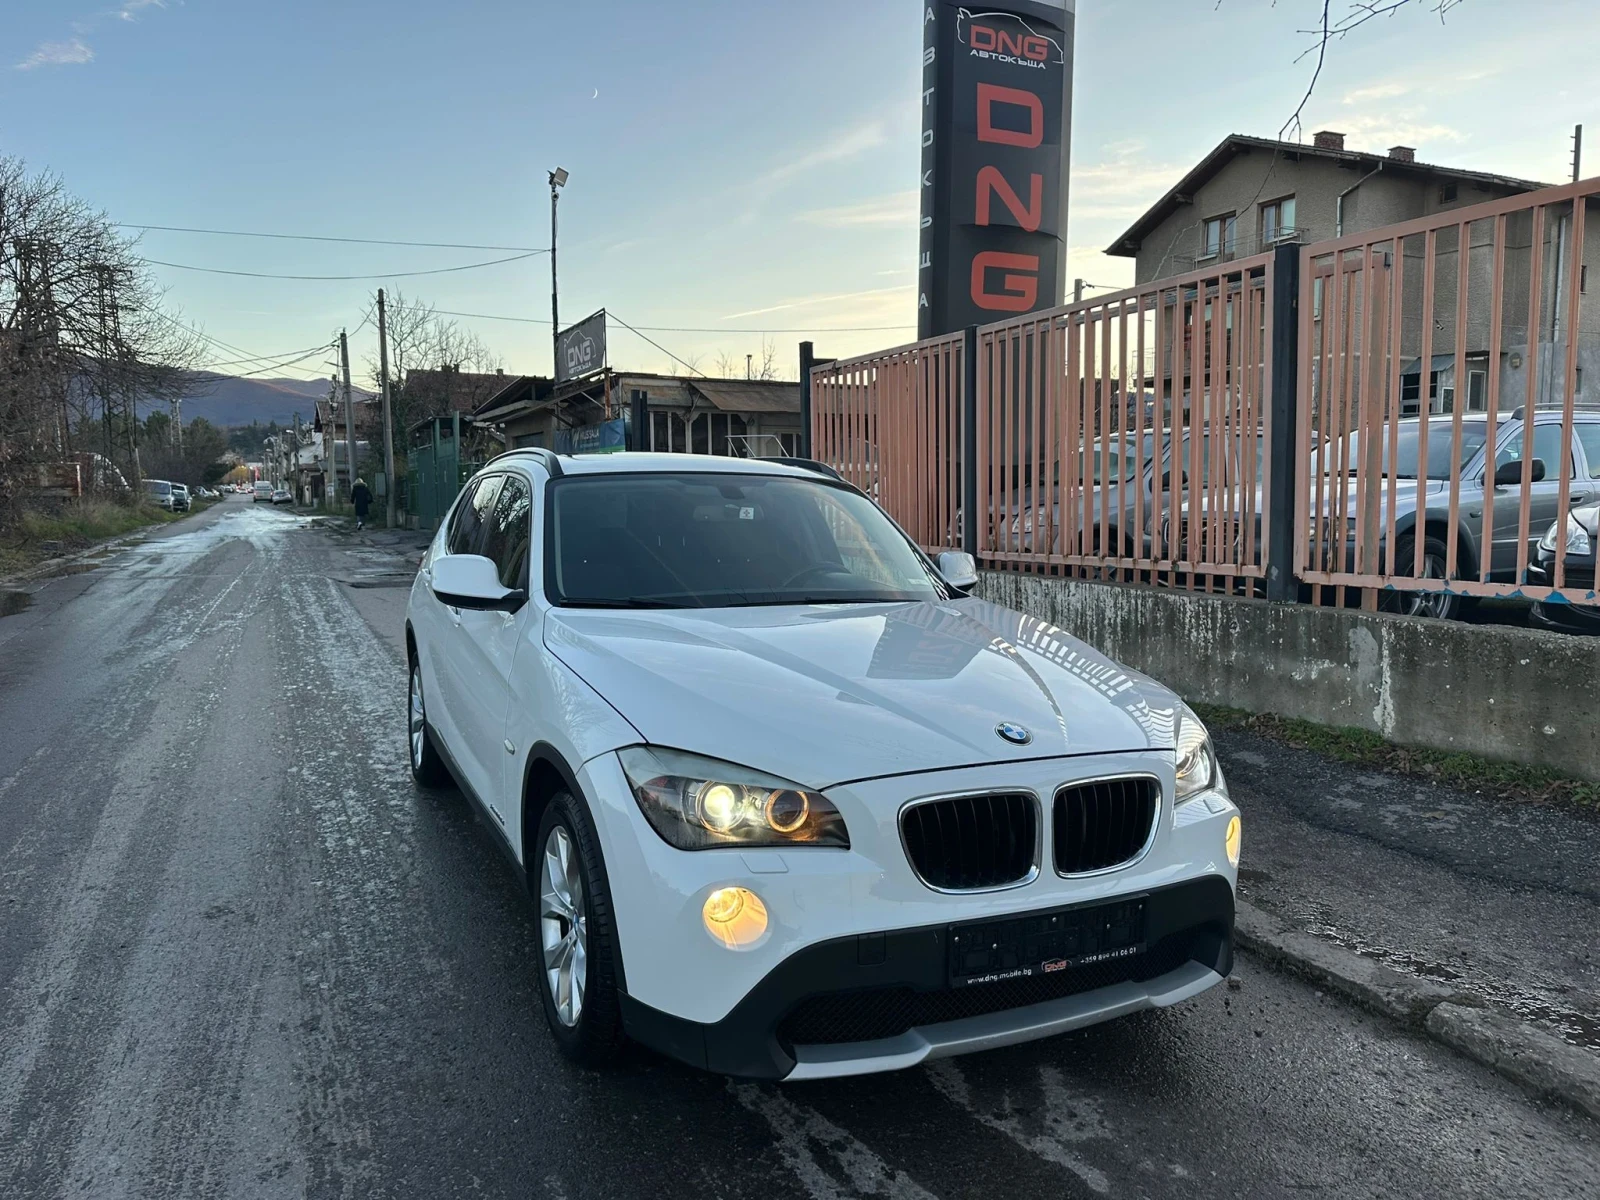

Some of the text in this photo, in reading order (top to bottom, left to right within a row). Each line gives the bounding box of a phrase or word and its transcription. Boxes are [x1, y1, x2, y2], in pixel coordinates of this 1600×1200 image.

[970, 24, 1048, 61] DNG
[970, 49, 1046, 70] АВТОКЪША
[918, 6, 936, 308] АВТОКЪША
[970, 82, 1044, 312] DNG
[567, 339, 591, 368] DNG
